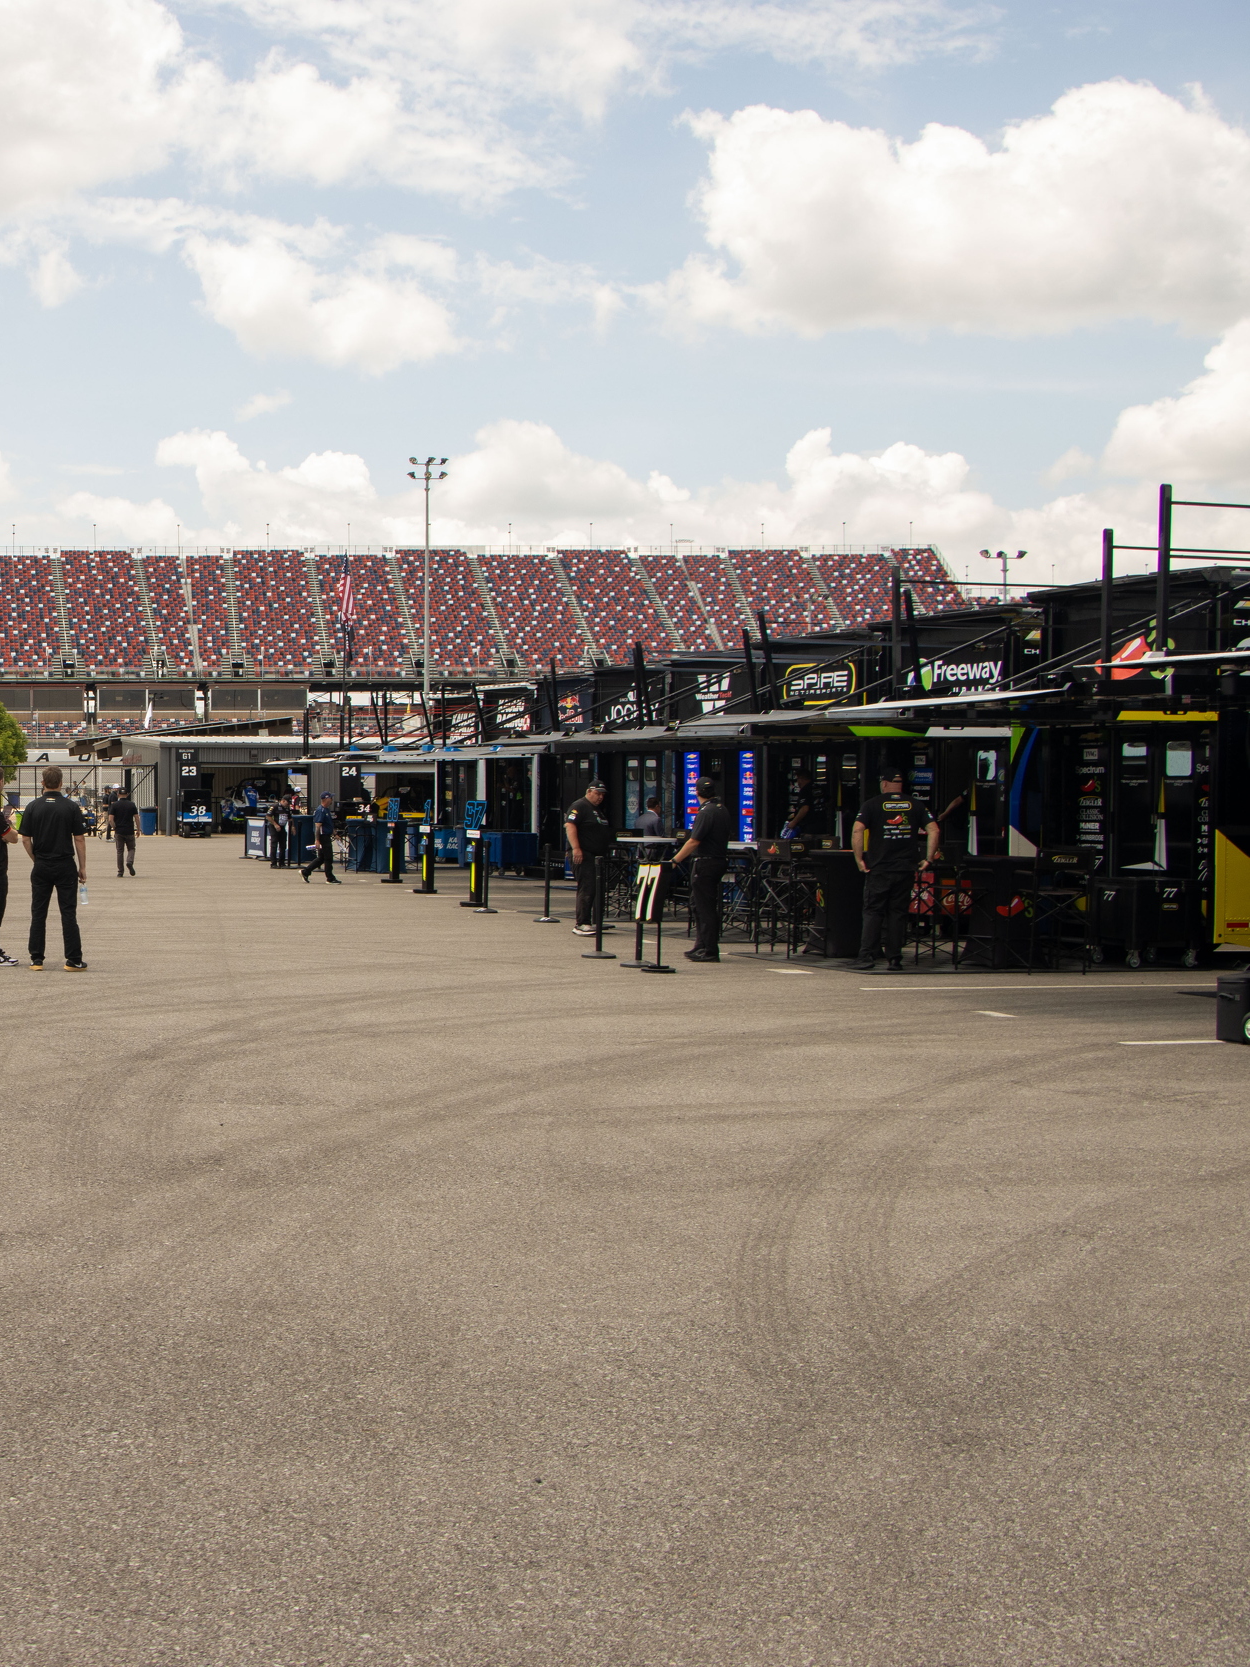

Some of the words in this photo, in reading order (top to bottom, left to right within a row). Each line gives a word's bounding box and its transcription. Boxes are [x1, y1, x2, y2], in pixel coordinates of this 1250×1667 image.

[790, 670, 848, 690] SPIRE
[181, 766, 197, 776] 23
[341, 766, 357, 776] 24
[1075, 765, 1106, 775] Spectrum
[189, 805, 207, 816] 38
[357, 804, 371, 812] 34
[422, 799, 431, 825] 1
[464, 800, 487, 829] 97
[635, 864, 662, 921] 77
[1103, 891, 1117, 901] 77
[1162, 887, 1179, 898] 77
